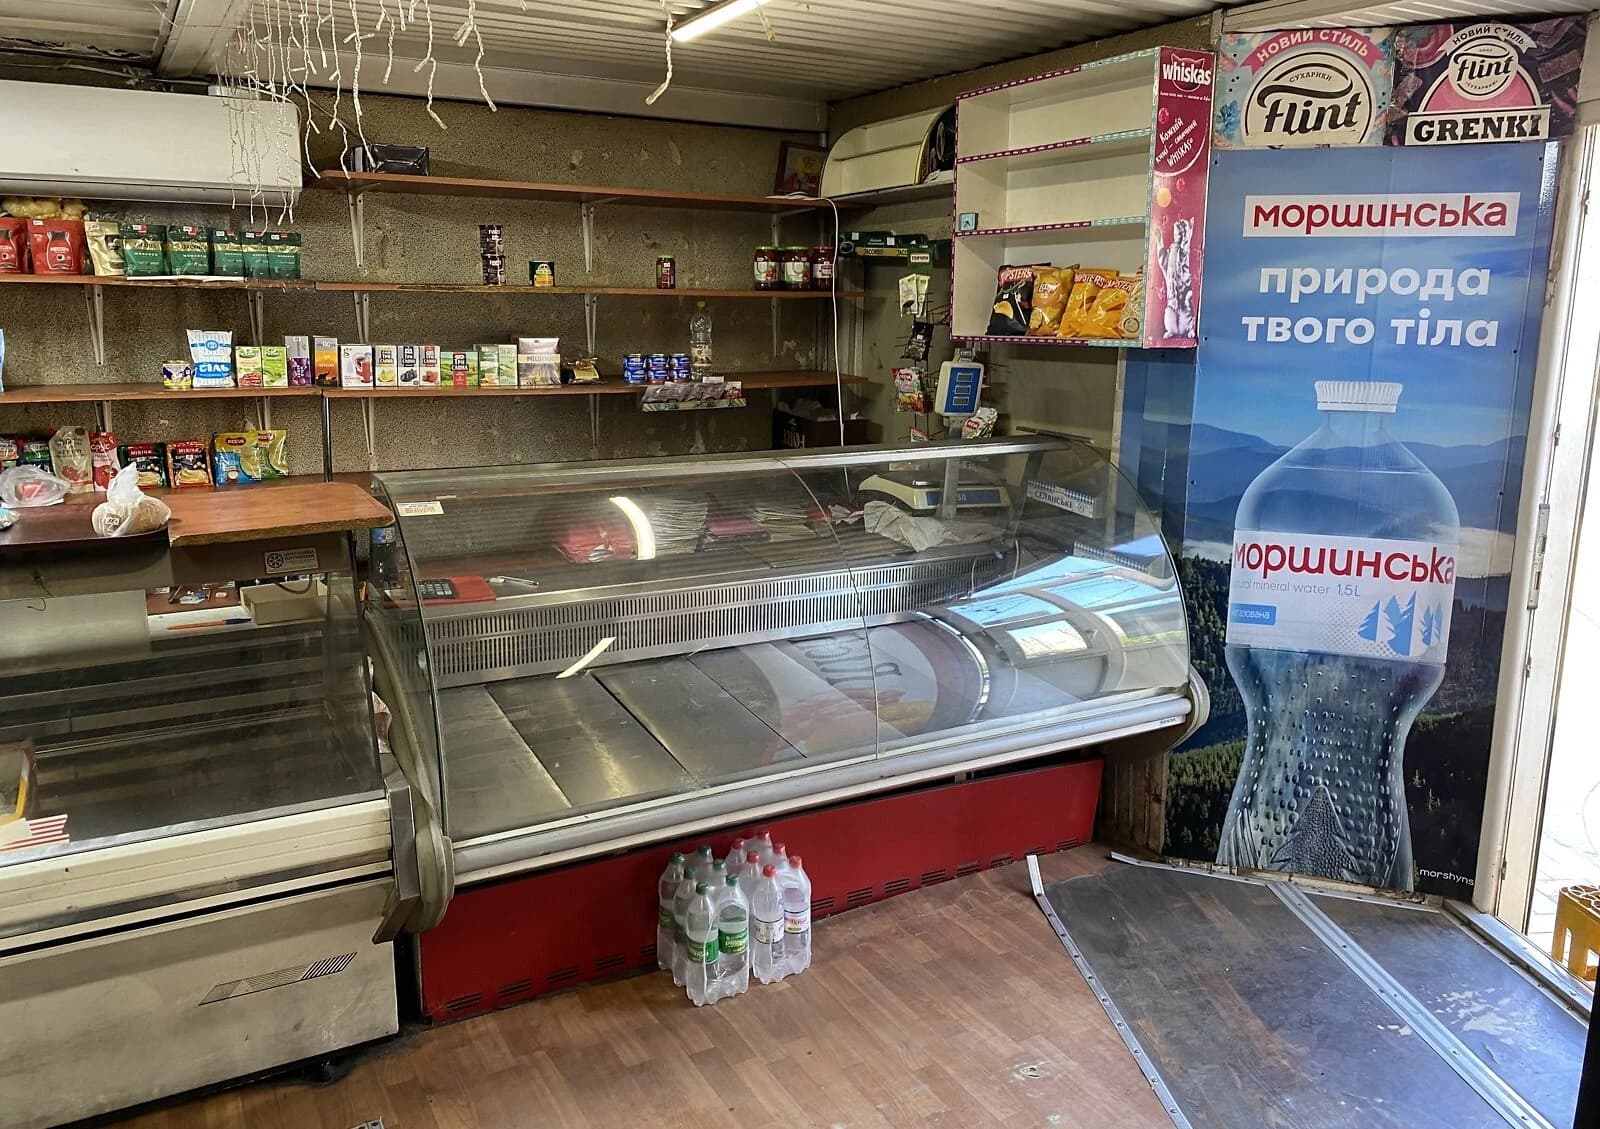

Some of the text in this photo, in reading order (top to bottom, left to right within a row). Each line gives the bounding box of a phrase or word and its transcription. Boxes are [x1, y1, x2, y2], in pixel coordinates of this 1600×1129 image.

[1319, 29, 1369, 57] СТИЛЬ
[1453, 25, 1491, 45] НОВИЙ
[1162, 61, 1212, 86] whiskas
[1289, 71, 1333, 83] СУХАРИКИ
[1413, 114, 1542, 142] GRENKI
[1253, 195, 1507, 235] моршинська
[1259, 267, 1492, 304] природа
[1241, 307, 1500, 347] твого тіла
[1293, 583, 1332, 595] water
[1419, 868, 1475, 886] morshyns
